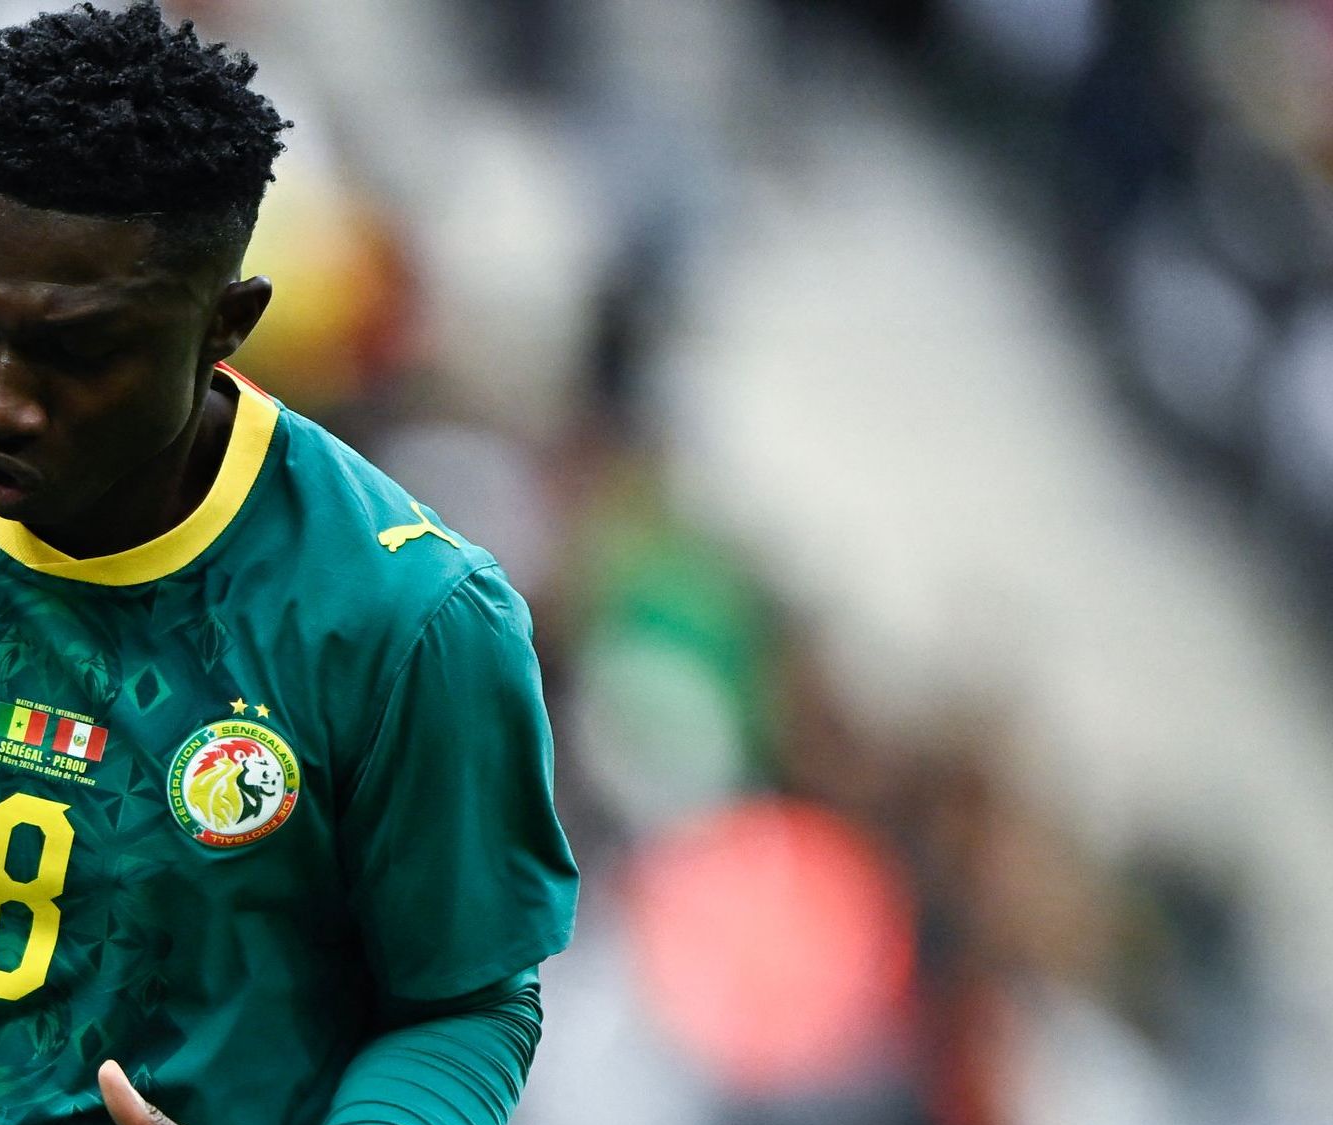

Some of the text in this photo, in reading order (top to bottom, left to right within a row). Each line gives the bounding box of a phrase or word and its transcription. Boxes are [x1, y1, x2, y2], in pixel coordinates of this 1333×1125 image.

[15, 698, 95, 724] MATCH AMICAL INTERNATIONAL
[0, 740, 43, 763] SÉNÉGAL
[53, 755, 88, 773] PEROU
[2, 756, 19, 766] Mars
[19, 760, 35, 770] 2026
[35, 765, 44, 773] au
[44, 766, 63, 778] Stade
[63, 771, 72, 780] de
[74, 775, 96, 786] France
[172, 724, 296, 844] FÉDÉRATION SÉNÉGALAISE DE FOOTBALL
